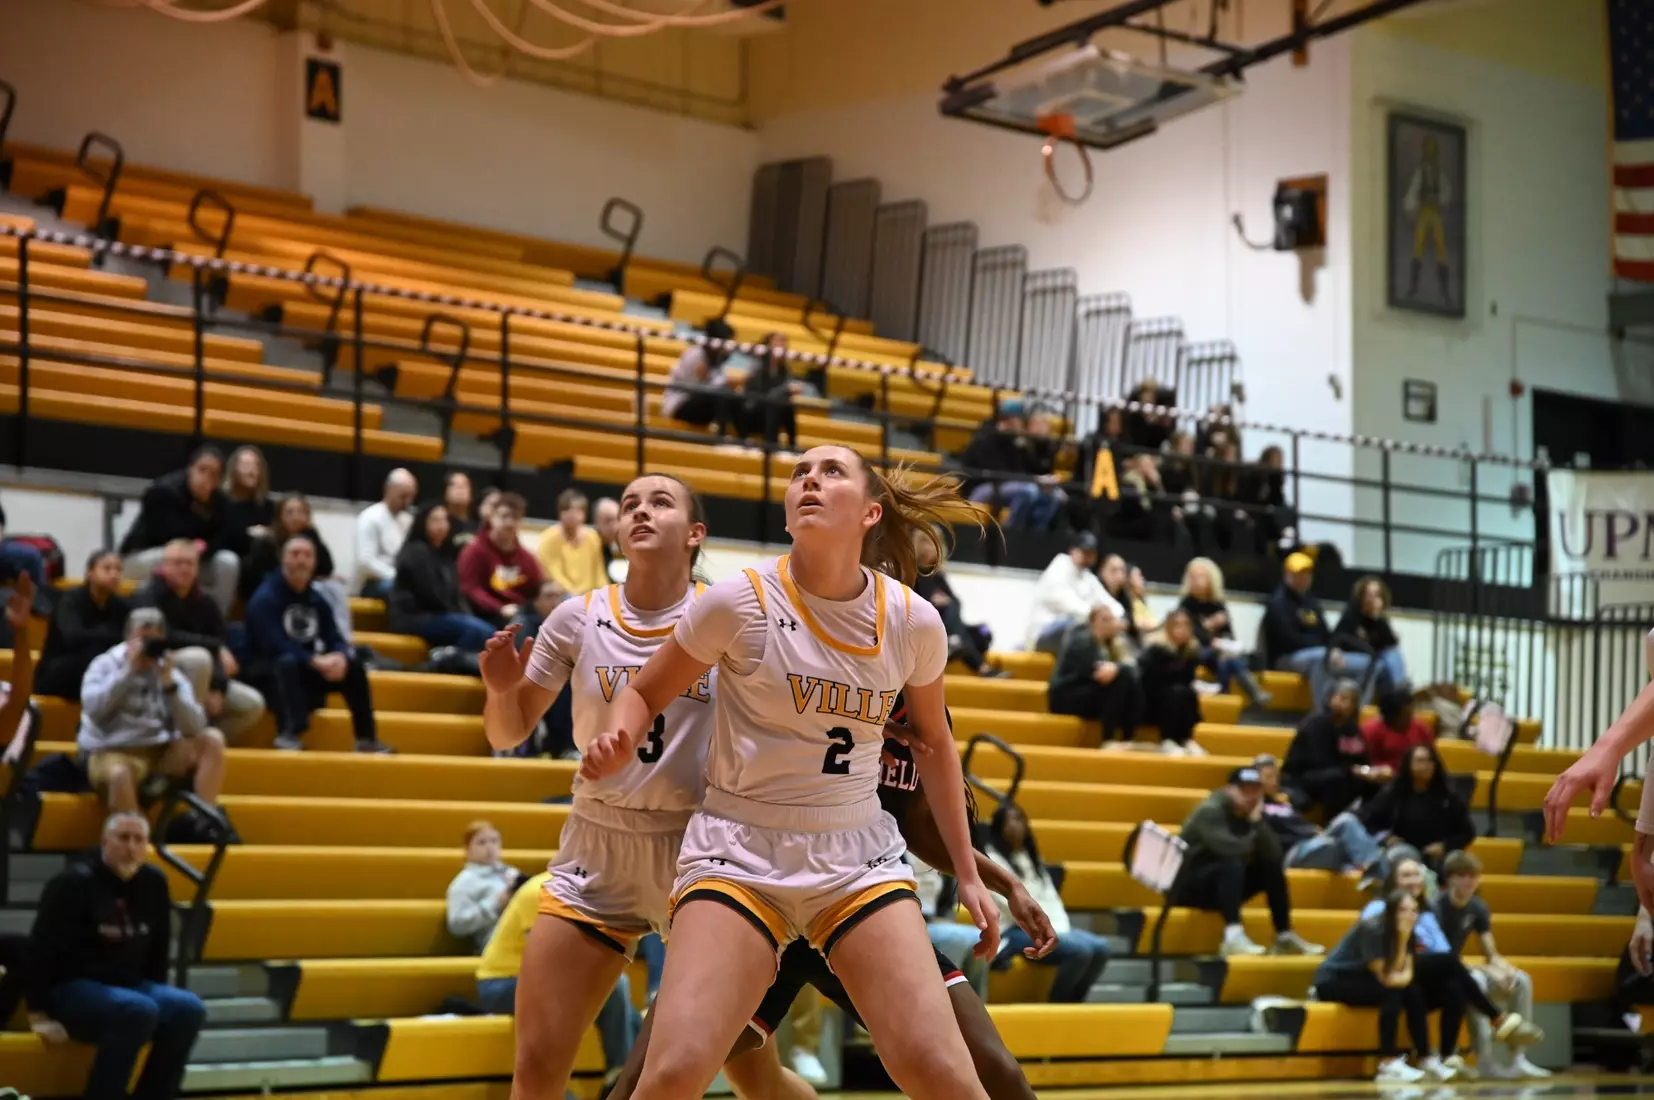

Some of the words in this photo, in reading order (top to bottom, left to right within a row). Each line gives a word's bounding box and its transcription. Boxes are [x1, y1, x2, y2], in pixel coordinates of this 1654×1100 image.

[311, 67, 339, 114] A
[1091, 448, 1119, 501] A
[637, 712, 665, 763] 3
[821, 726, 855, 774] 2
